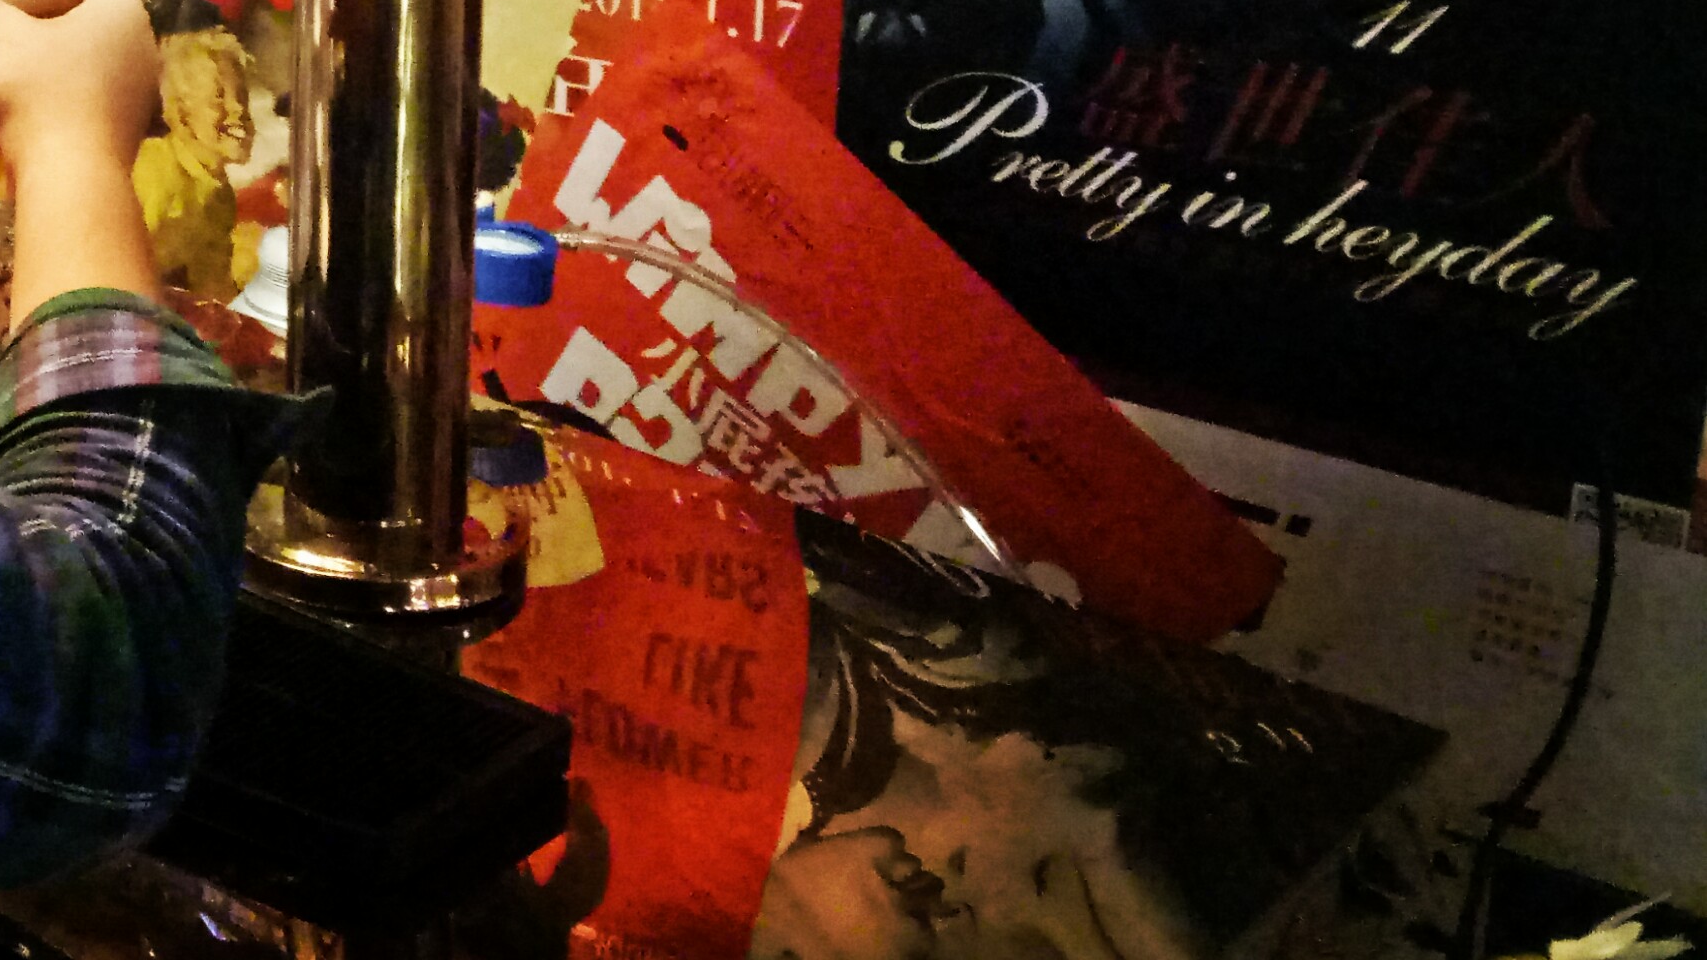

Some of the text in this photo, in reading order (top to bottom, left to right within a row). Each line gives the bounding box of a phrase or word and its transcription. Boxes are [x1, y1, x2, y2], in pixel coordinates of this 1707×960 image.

[888, 70, 1171, 242] Pretty
[1180, 170, 1272, 237] in
[1283, 178, 1638, 341] heyday
